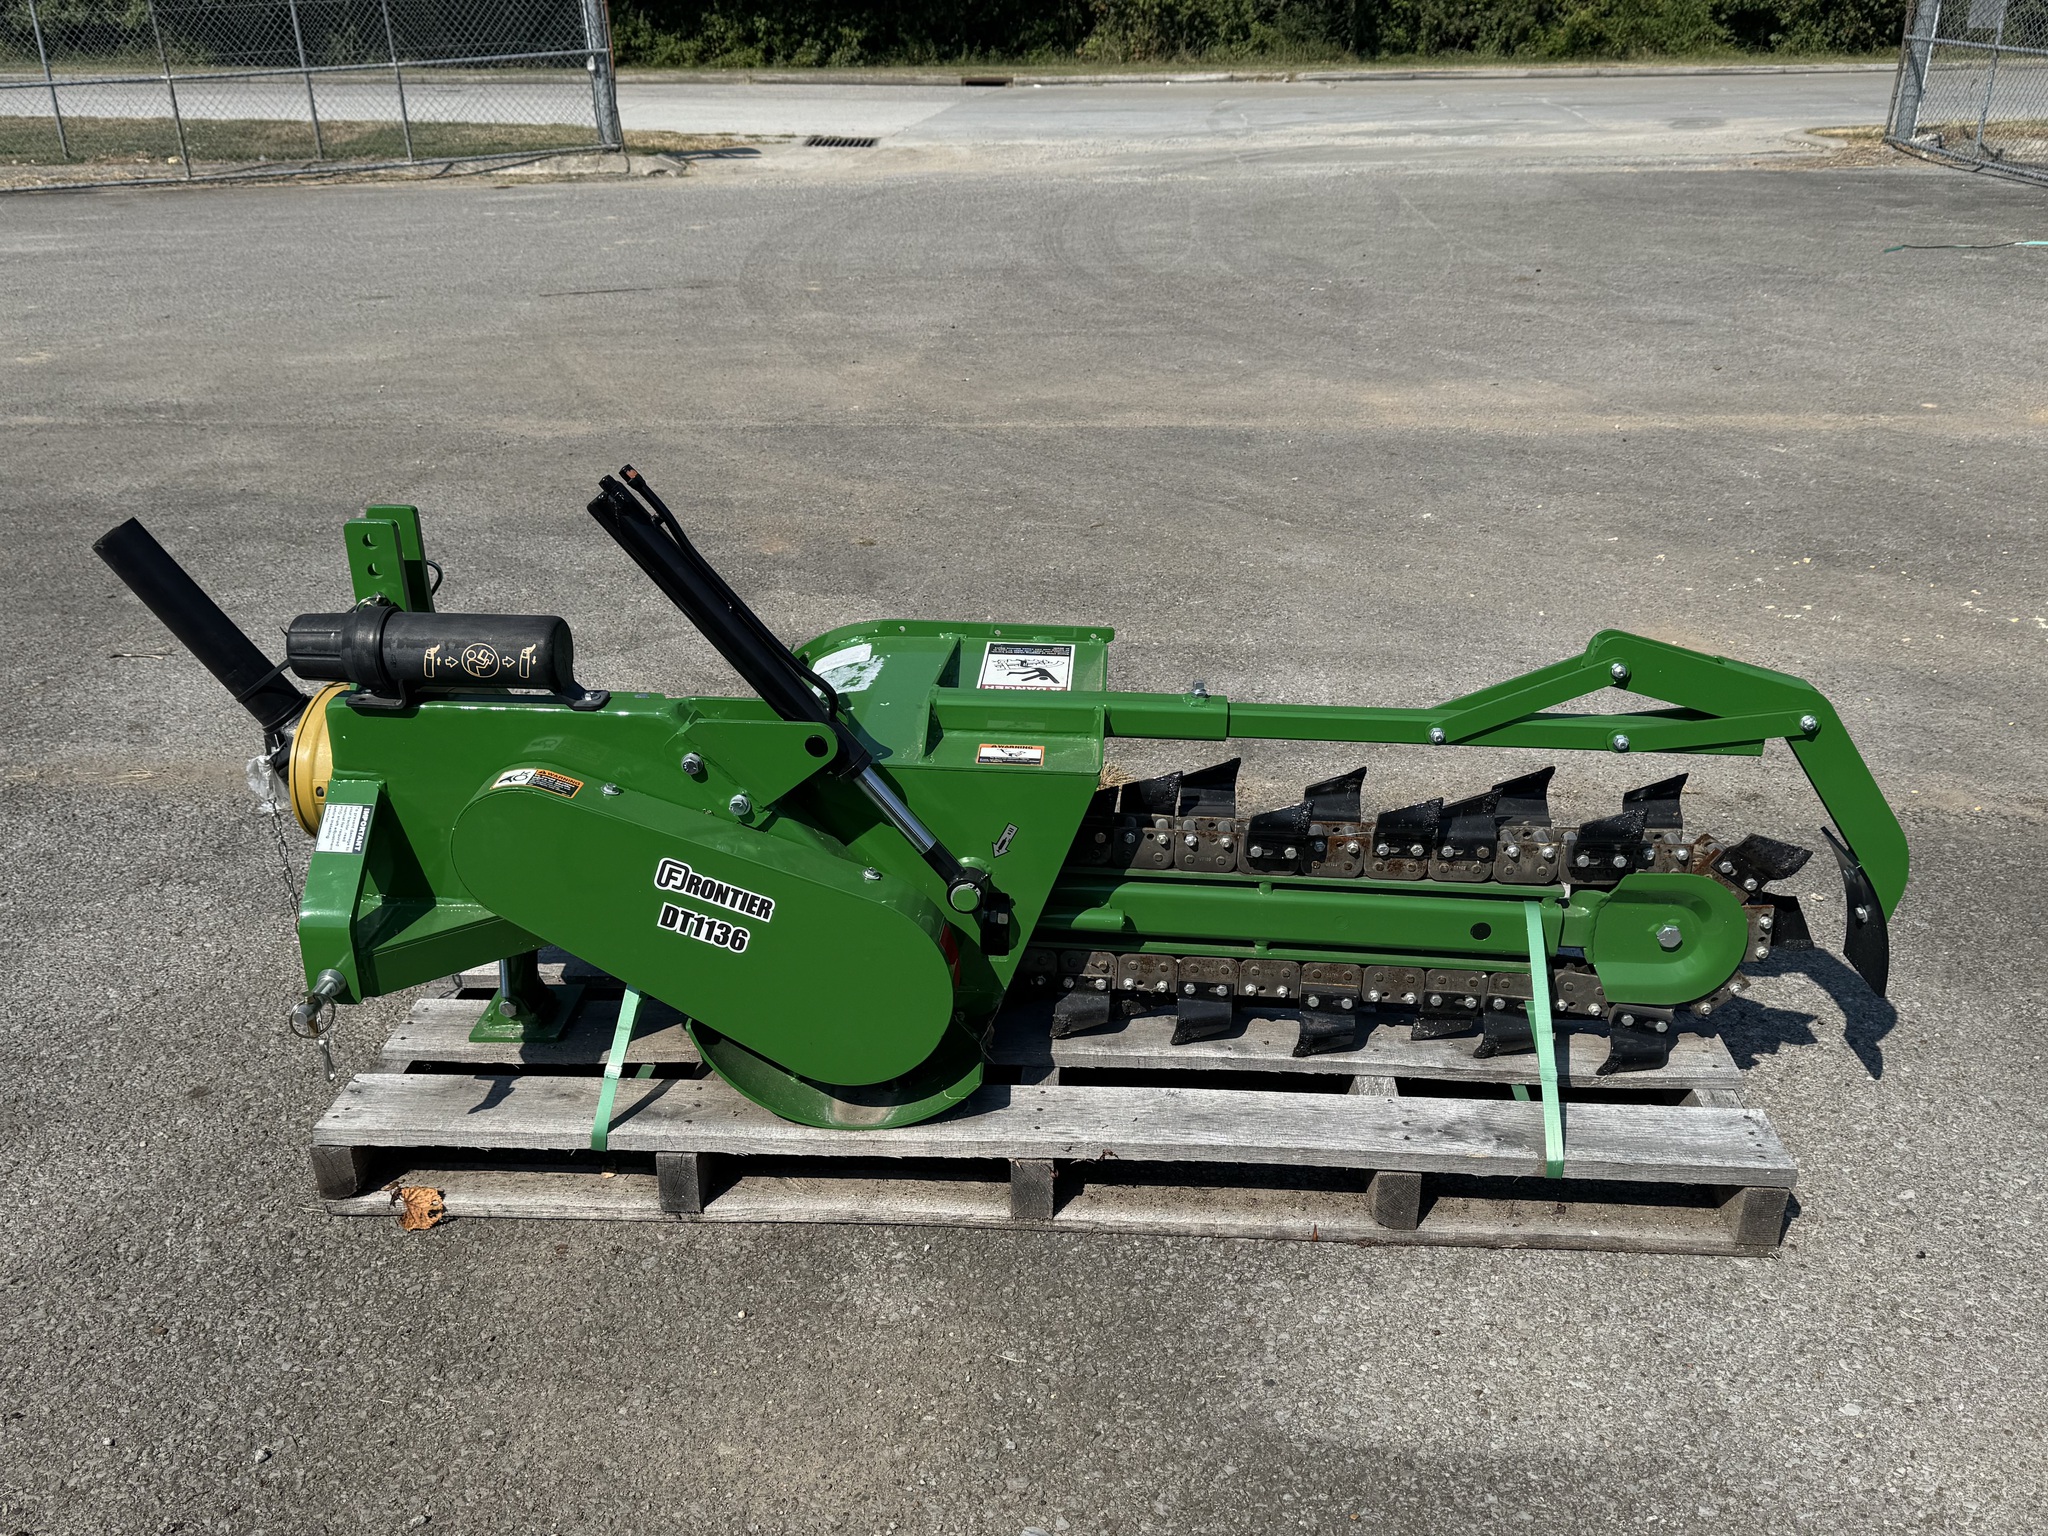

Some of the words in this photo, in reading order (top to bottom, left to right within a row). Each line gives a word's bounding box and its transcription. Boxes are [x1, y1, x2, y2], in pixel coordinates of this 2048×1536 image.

[548, 772, 581, 786] WARNING
[355, 808, 370, 851] IMPORTANT
[656, 859, 773, 920] FRONTIER
[660, 904, 748, 951] DT1136
